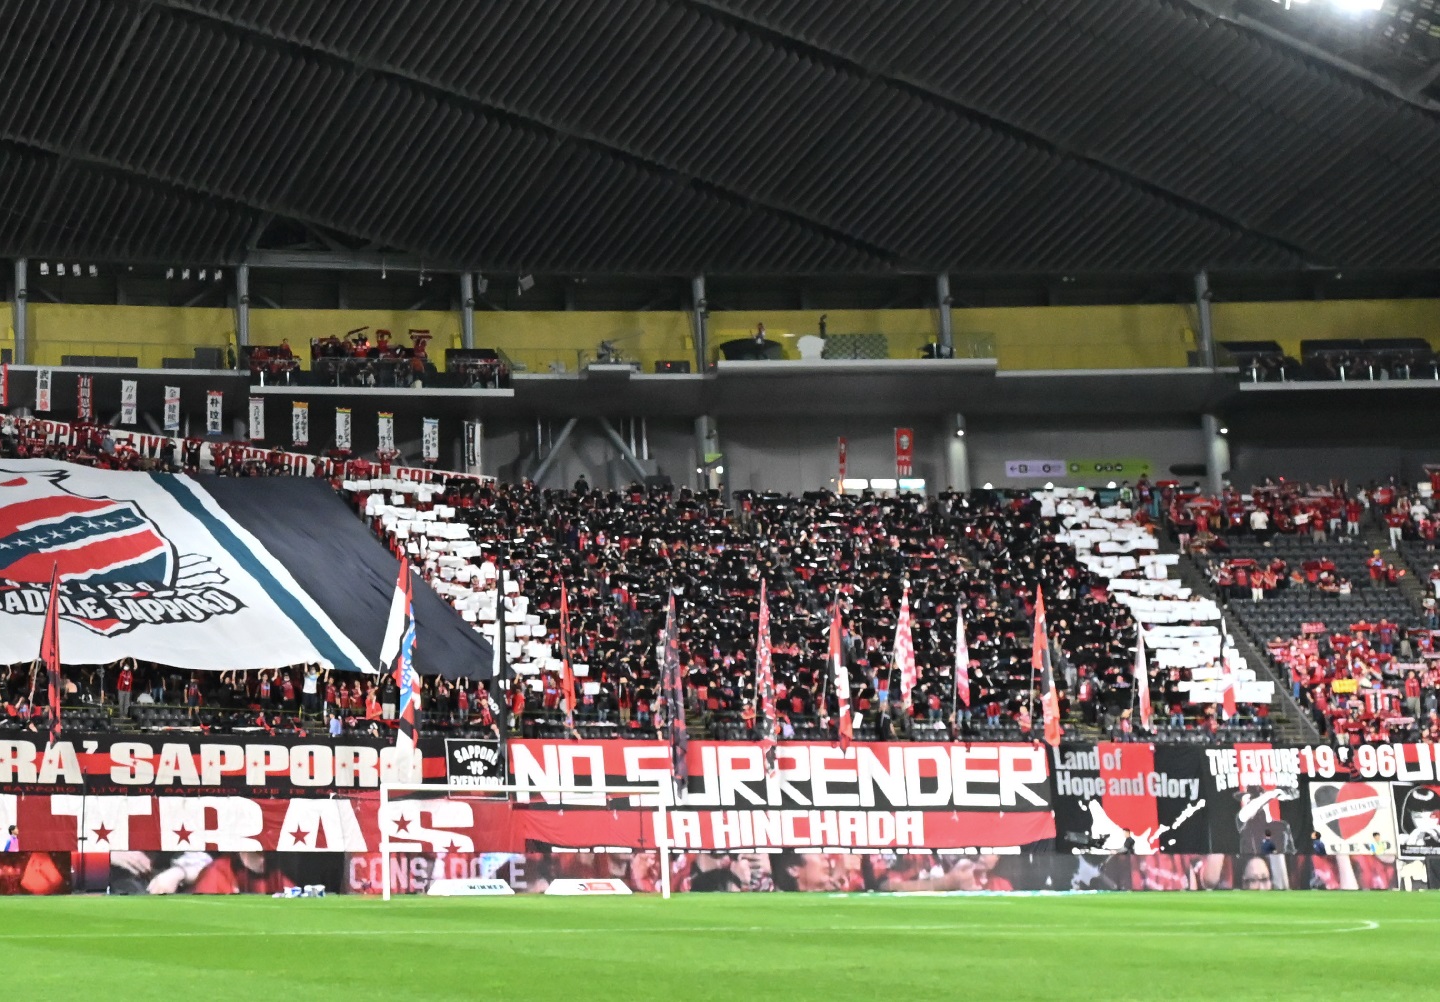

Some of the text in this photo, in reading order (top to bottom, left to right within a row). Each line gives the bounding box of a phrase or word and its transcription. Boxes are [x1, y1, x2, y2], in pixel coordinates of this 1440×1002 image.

[114, 588, 239, 624] SAPPORO
[510, 743, 1049, 808] NO SURRENDER
[1053, 746, 1123, 771] Land of
[1205, 747, 1301, 776] THE FUTURE
[1300, 743, 1397, 779] 19 96
[1056, 770, 1200, 801] Hope and Glory
[710, 808, 925, 848] HINCHADA
